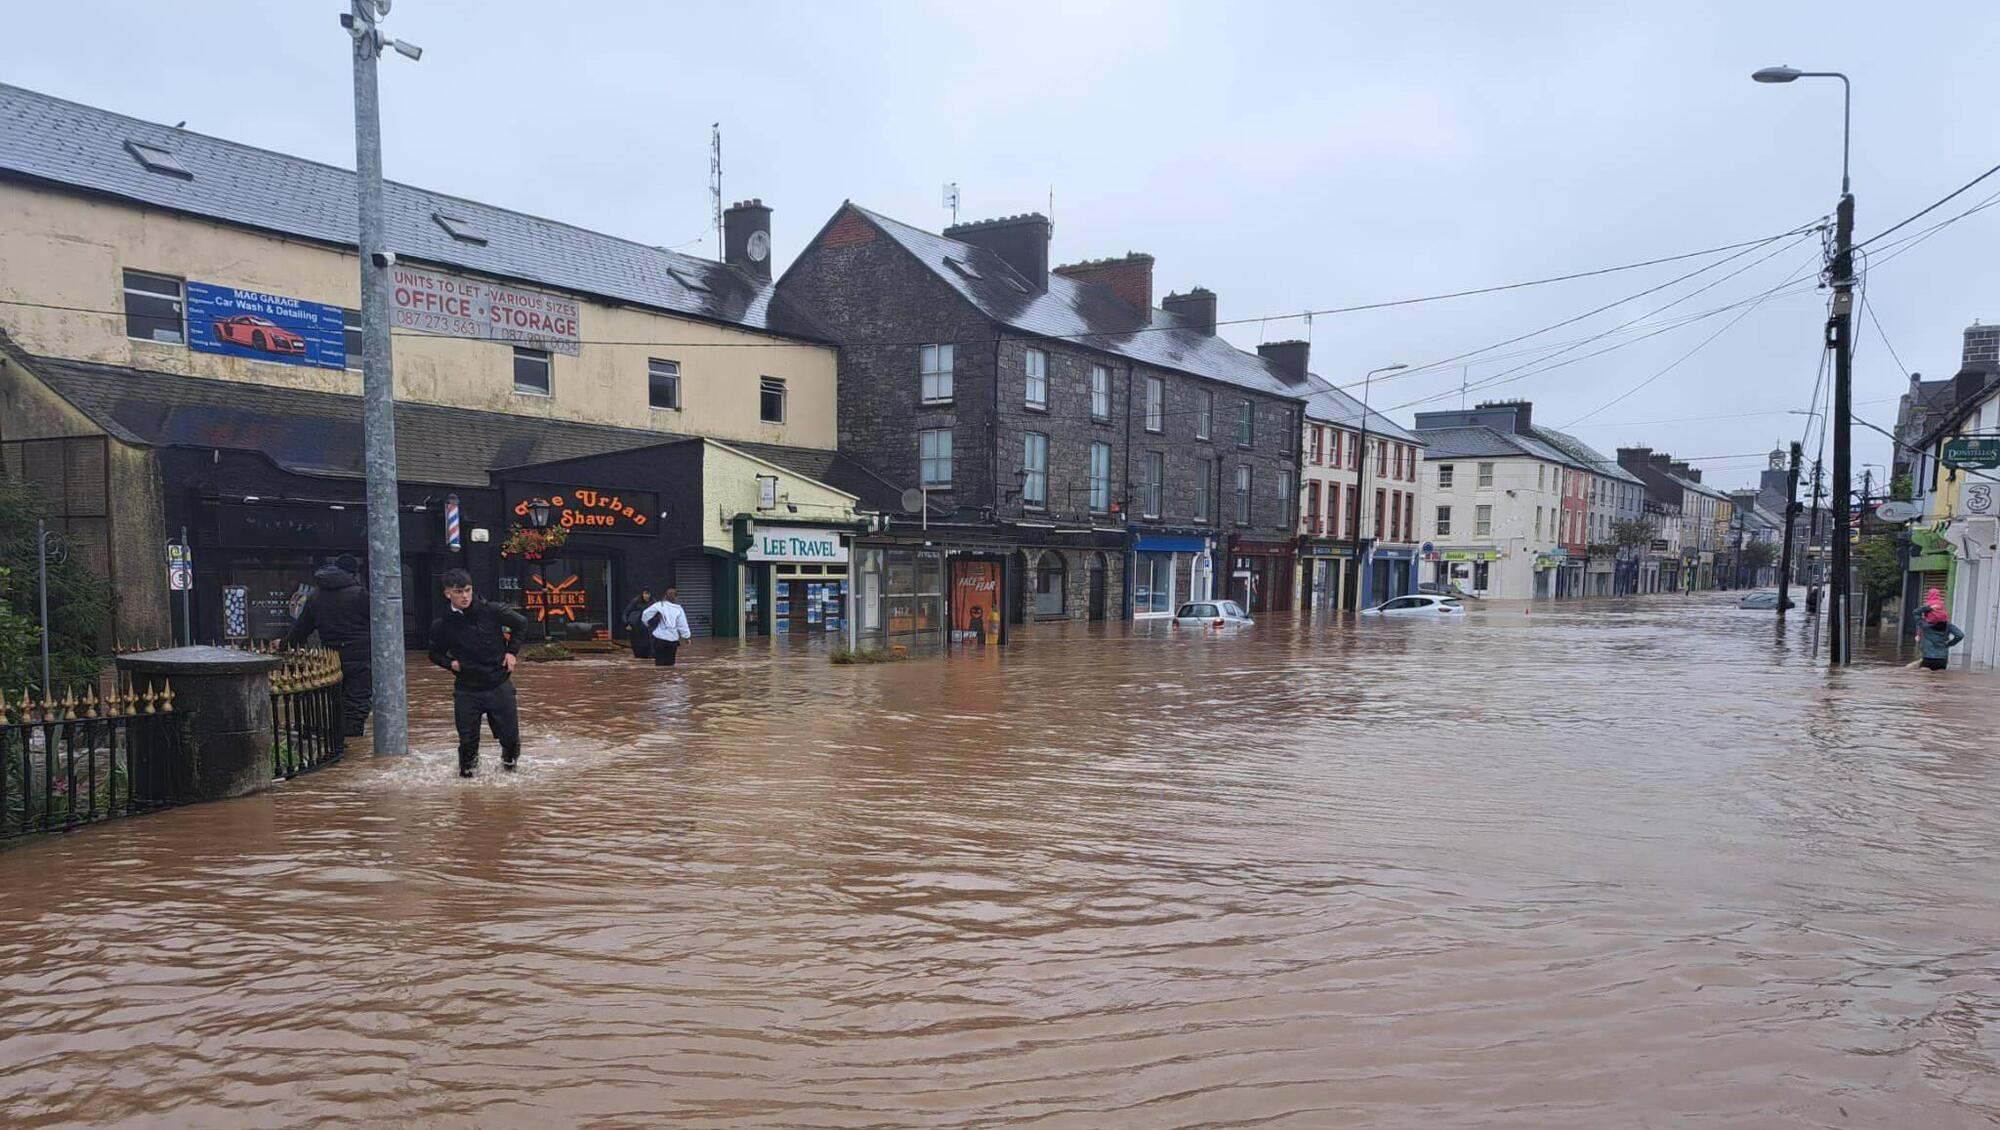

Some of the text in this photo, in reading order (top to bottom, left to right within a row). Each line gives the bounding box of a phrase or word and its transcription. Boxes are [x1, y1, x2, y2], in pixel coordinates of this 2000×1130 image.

[234, 290, 300, 308] MAG GARAGE
[395, 271, 433, 289] UNITS
[437, 279, 454, 293] TO
[459, 285, 480, 298] LET
[491, 290, 542, 309] VARIOUS
[546, 301, 577, 317] SIZES
[215, 297, 233, 308] Car
[236, 299, 264, 313] Wash
[266, 305, 273, 314] &
[276, 306, 318, 323] Detailing
[395, 288, 577, 337] OFFICE STORAGE
[397, 310, 420, 326] 087
[425, 314, 448, 331] 273
[453, 320, 480, 336] 5631
[575, 490, 647, 525] Urban
[1967, 484, 1992, 511] 3
[561, 509, 614, 527] Shave
[763, 537, 836, 557] LEE TRAVEL
[958, 577, 977, 587] FACE
[975, 580, 996, 591] FEAR
[962, 631, 978, 639] WIN
